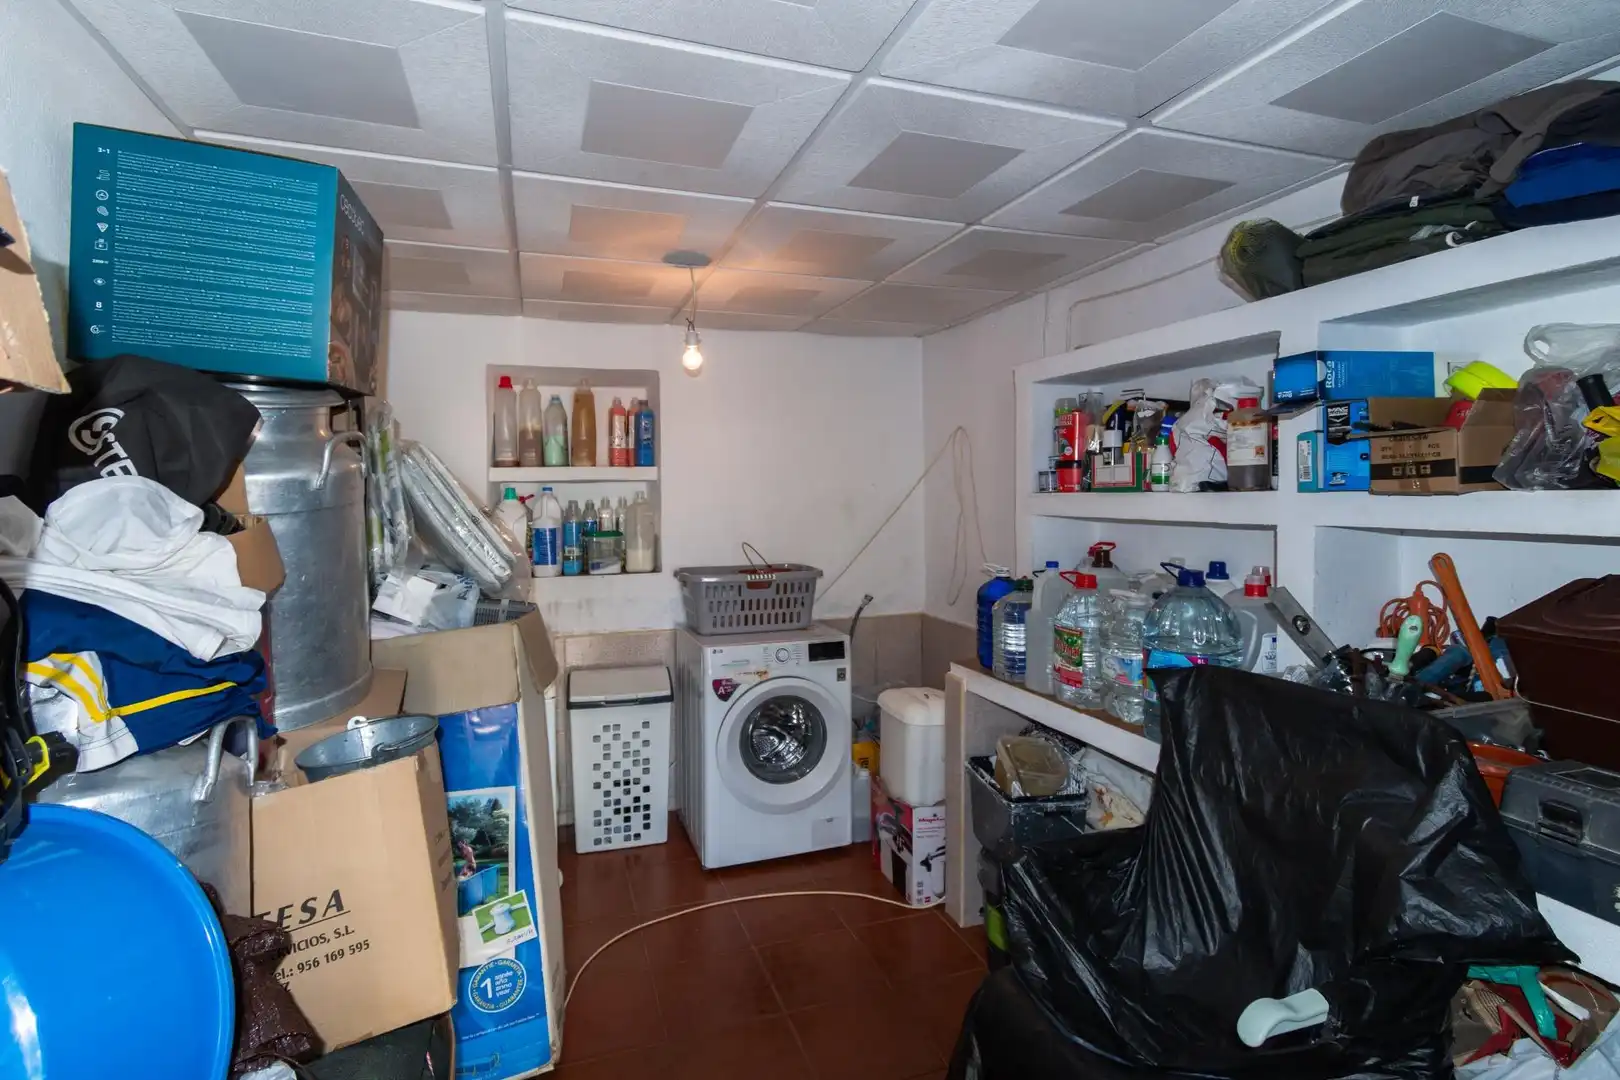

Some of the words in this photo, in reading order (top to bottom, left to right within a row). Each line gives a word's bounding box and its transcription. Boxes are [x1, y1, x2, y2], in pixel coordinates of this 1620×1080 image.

[1325, 360, 1333, 389] Roca
[296, 956, 321, 974] 956
[323, 948, 346, 964] 169
[348, 939, 371, 956] 595
[480, 977, 493, 999] 1
[495, 988, 511, 997] year
